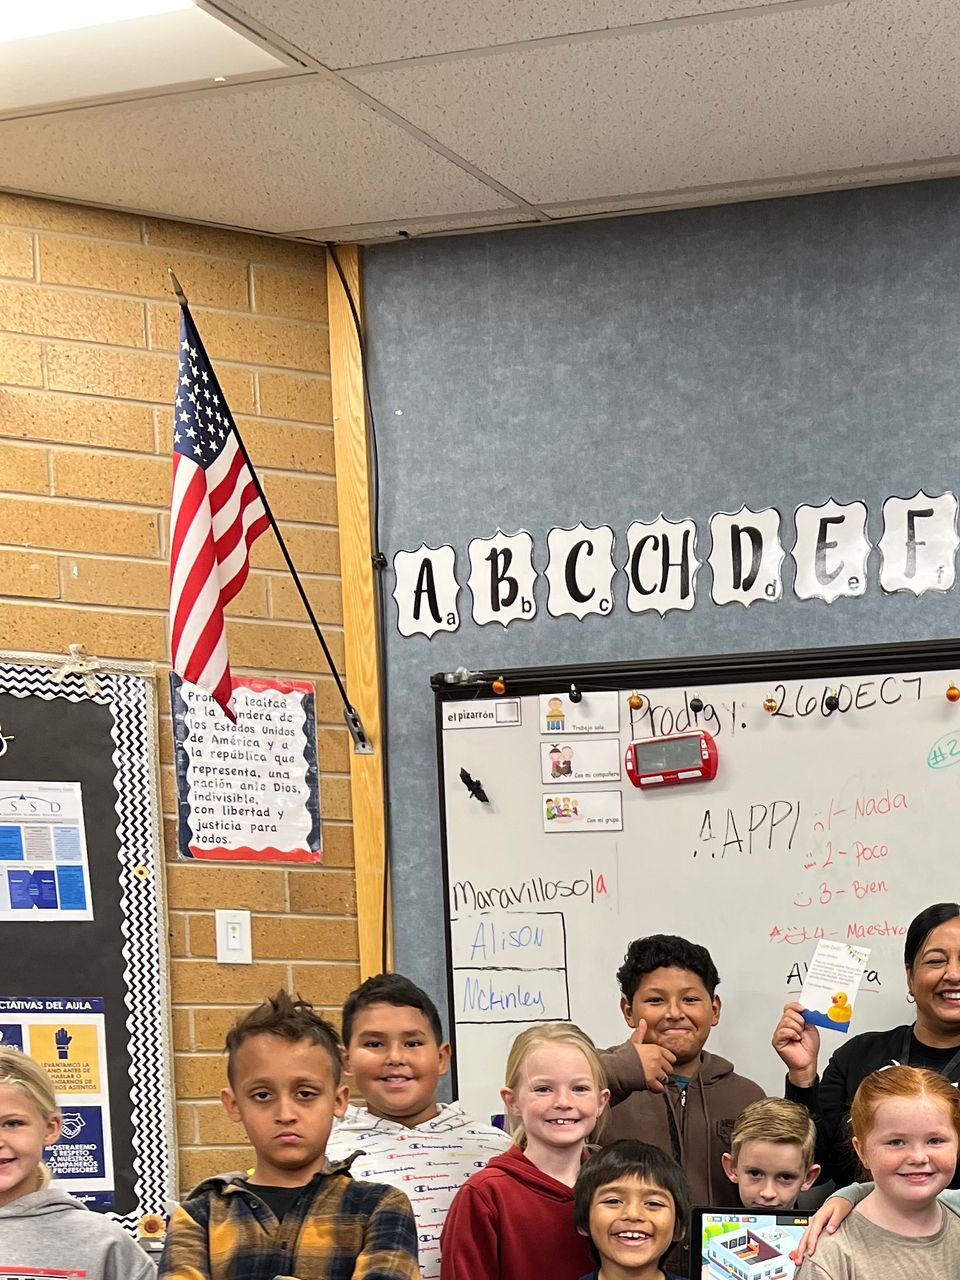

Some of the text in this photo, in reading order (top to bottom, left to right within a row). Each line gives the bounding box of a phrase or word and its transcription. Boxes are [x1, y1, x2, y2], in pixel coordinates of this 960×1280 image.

[814, 515, 860, 590] E e
[904, 508, 946, 584] F f
[630, 529, 690, 600] CH
[731, 524, 777, 597] D d
[485, 547, 532, 613] B b
[564, 540, 609, 612] C c
[413, 557, 456, 626] A a
[204, 707, 216, 717] la
[280, 713, 293, 723] de
[458, 709, 494, 721] pizarrón
[190, 721, 295, 737] los Estados Unidos
[190, 735, 204, 744] de
[211, 735, 260, 748] América
[268, 742, 274, 751] y
[192, 747, 295, 766] la república que
[269, 771, 290, 779] una
[194, 779, 301, 794] nación ante Dios,
[194, 806, 284, 819] con libertad y
[855, 789, 908, 820] Nada
[196, 819, 277, 833] justicia para
[196, 833, 232, 844] todos.
[854, 840, 889, 867] Poco
[852, 879, 888, 900] Bien
[46, 1001, 63, 1010] DEL
[66, 1001, 92, 1010] AULA
